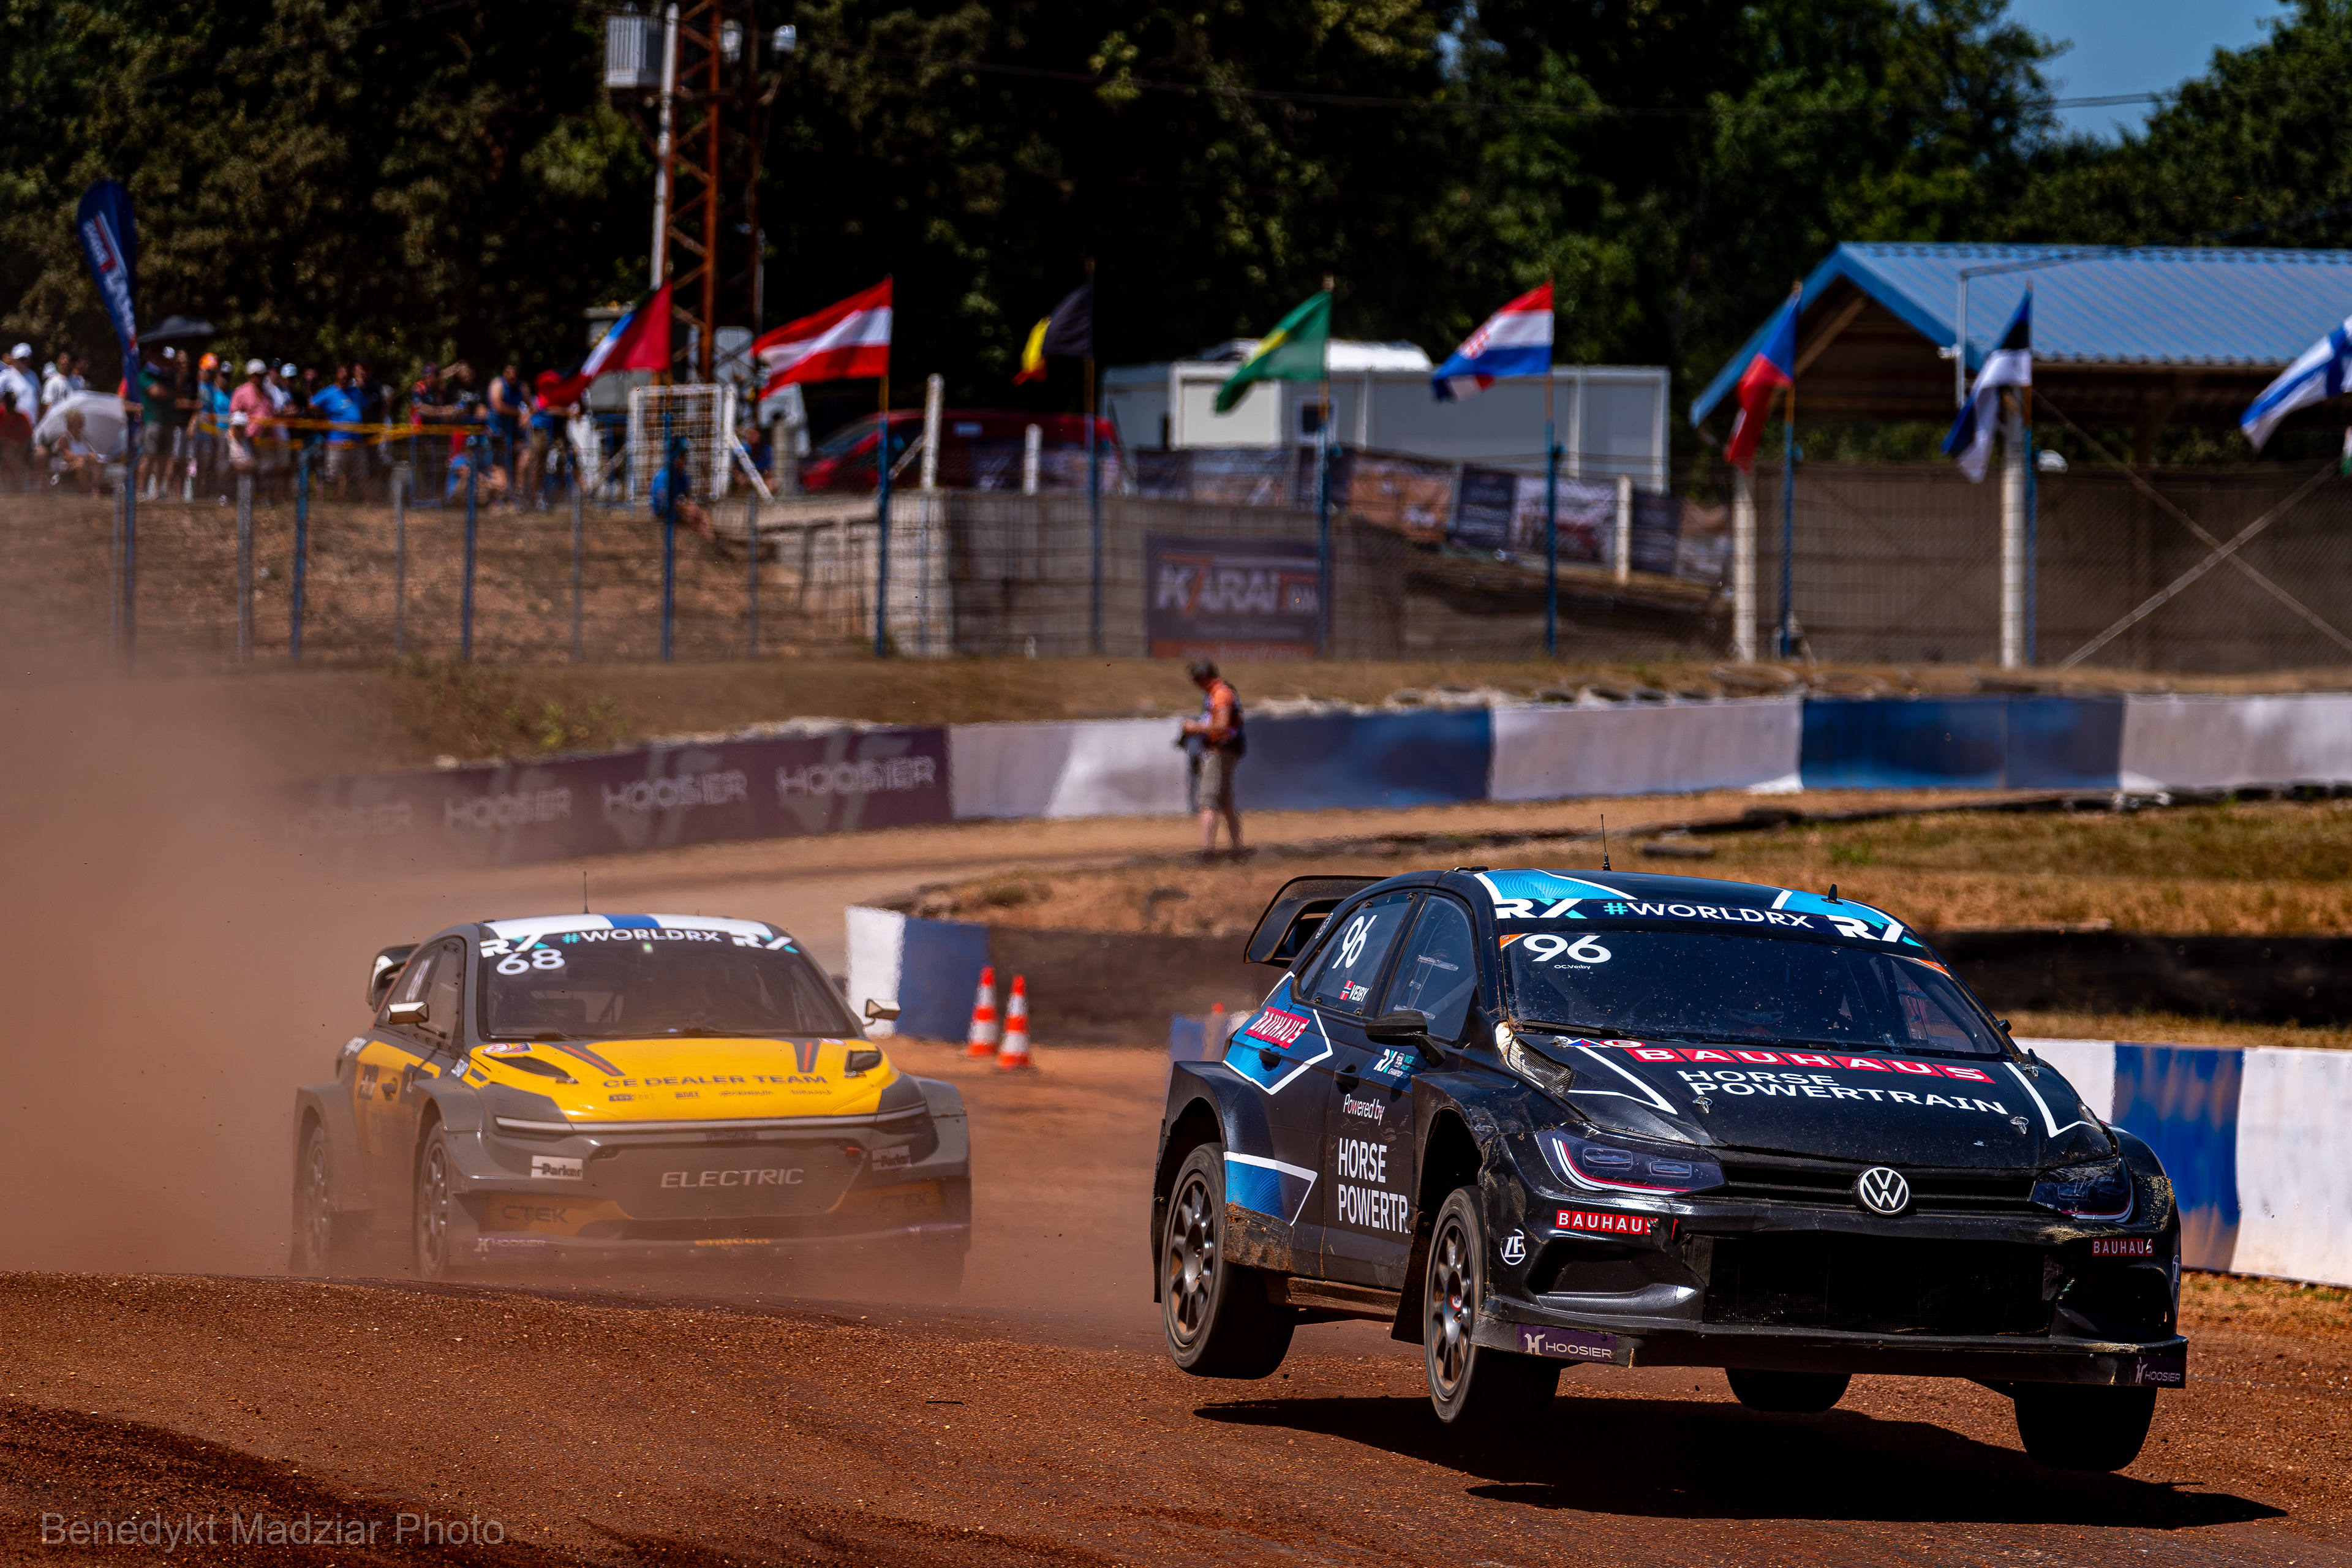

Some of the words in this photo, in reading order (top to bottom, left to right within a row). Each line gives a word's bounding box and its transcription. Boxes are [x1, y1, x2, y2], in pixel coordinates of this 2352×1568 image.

[1604, 902, 1814, 929] #WORLDRX
[562, 929, 722, 945] #WORLDRX
[1332, 914, 1378, 969] 96
[1523, 934, 1611, 963] 96
[497, 948, 565, 976] 68
[1349, 984, 1370, 1002] VEIBY
[1250, 1011, 1308, 1044] BAUHAUS
[1635, 1049, 1985, 1080] BAUHAUS
[603, 1079, 637, 1088] CE
[645, 1075, 746, 1087] DEALER
[753, 1074, 829, 1085] TEAM
[1676, 1070, 1841, 1087] HORSE
[1343, 1093, 1376, 1119] Powered
[1374, 1099, 1385, 1126] by
[1689, 1082, 2010, 1115] POWERTRAIN
[541, 1162, 582, 1177] Parker
[1338, 1137, 1387, 1183] HORSE
[660, 1167, 804, 1188] ELECTRIC
[503, 1205, 568, 1224] CTEK
[1338, 1183, 1411, 1235] POWERTR
[1546, 1341, 1612, 1359] HOOSIER
[2144, 1371, 2180, 1382] HOOSIER
